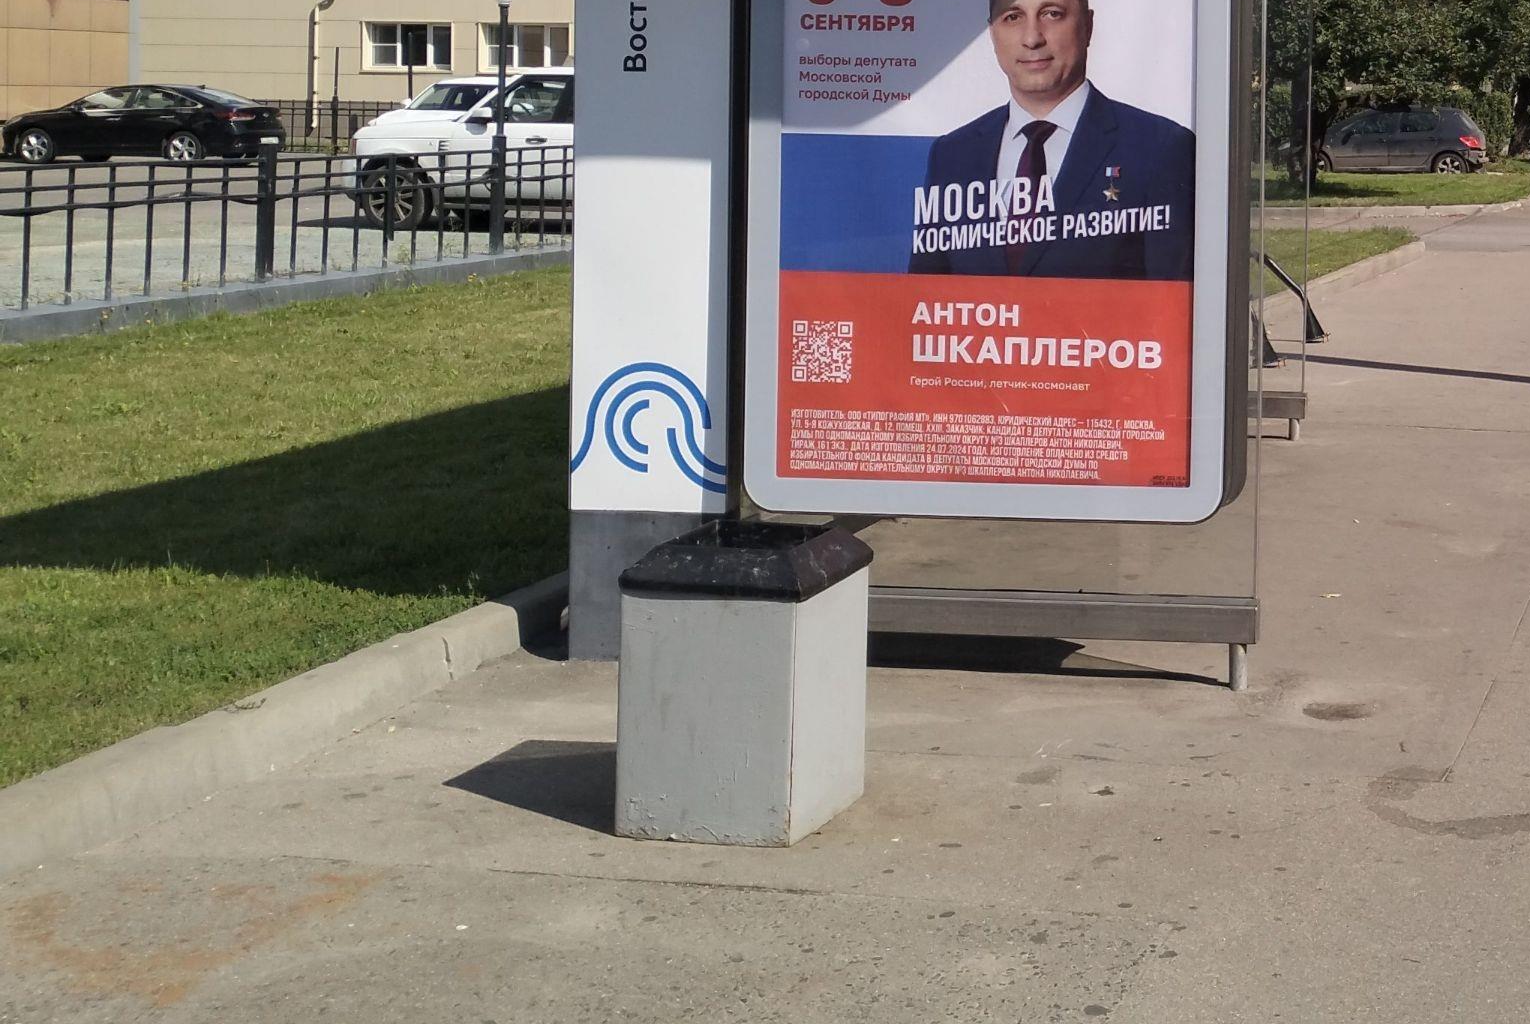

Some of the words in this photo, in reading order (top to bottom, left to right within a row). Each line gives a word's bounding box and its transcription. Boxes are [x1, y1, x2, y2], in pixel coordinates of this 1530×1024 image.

[800, 13, 915, 32] СЕНТЯБРЯ
[799, 54, 851, 67] выборы
[854, 57, 917, 69] депутата
[799, 71, 882, 84] Московской
[799, 89, 869, 101] городской
[872, 90, 911, 102] Думы
[913, 175, 1056, 226] МОСКВА
[912, 216, 1057, 255] КОСМИЧЕСКОЕ
[1063, 205, 1170, 240] РАЗВИТИЕ!
[912, 302, 1020, 327] АНТОН
[912, 334, 1163, 369] ШКАПЛЕРОВ
[910, 376, 942, 388] Герой
[944, 377, 987, 390] России,
[989, 380, 1090, 392] летчик-космонавт
